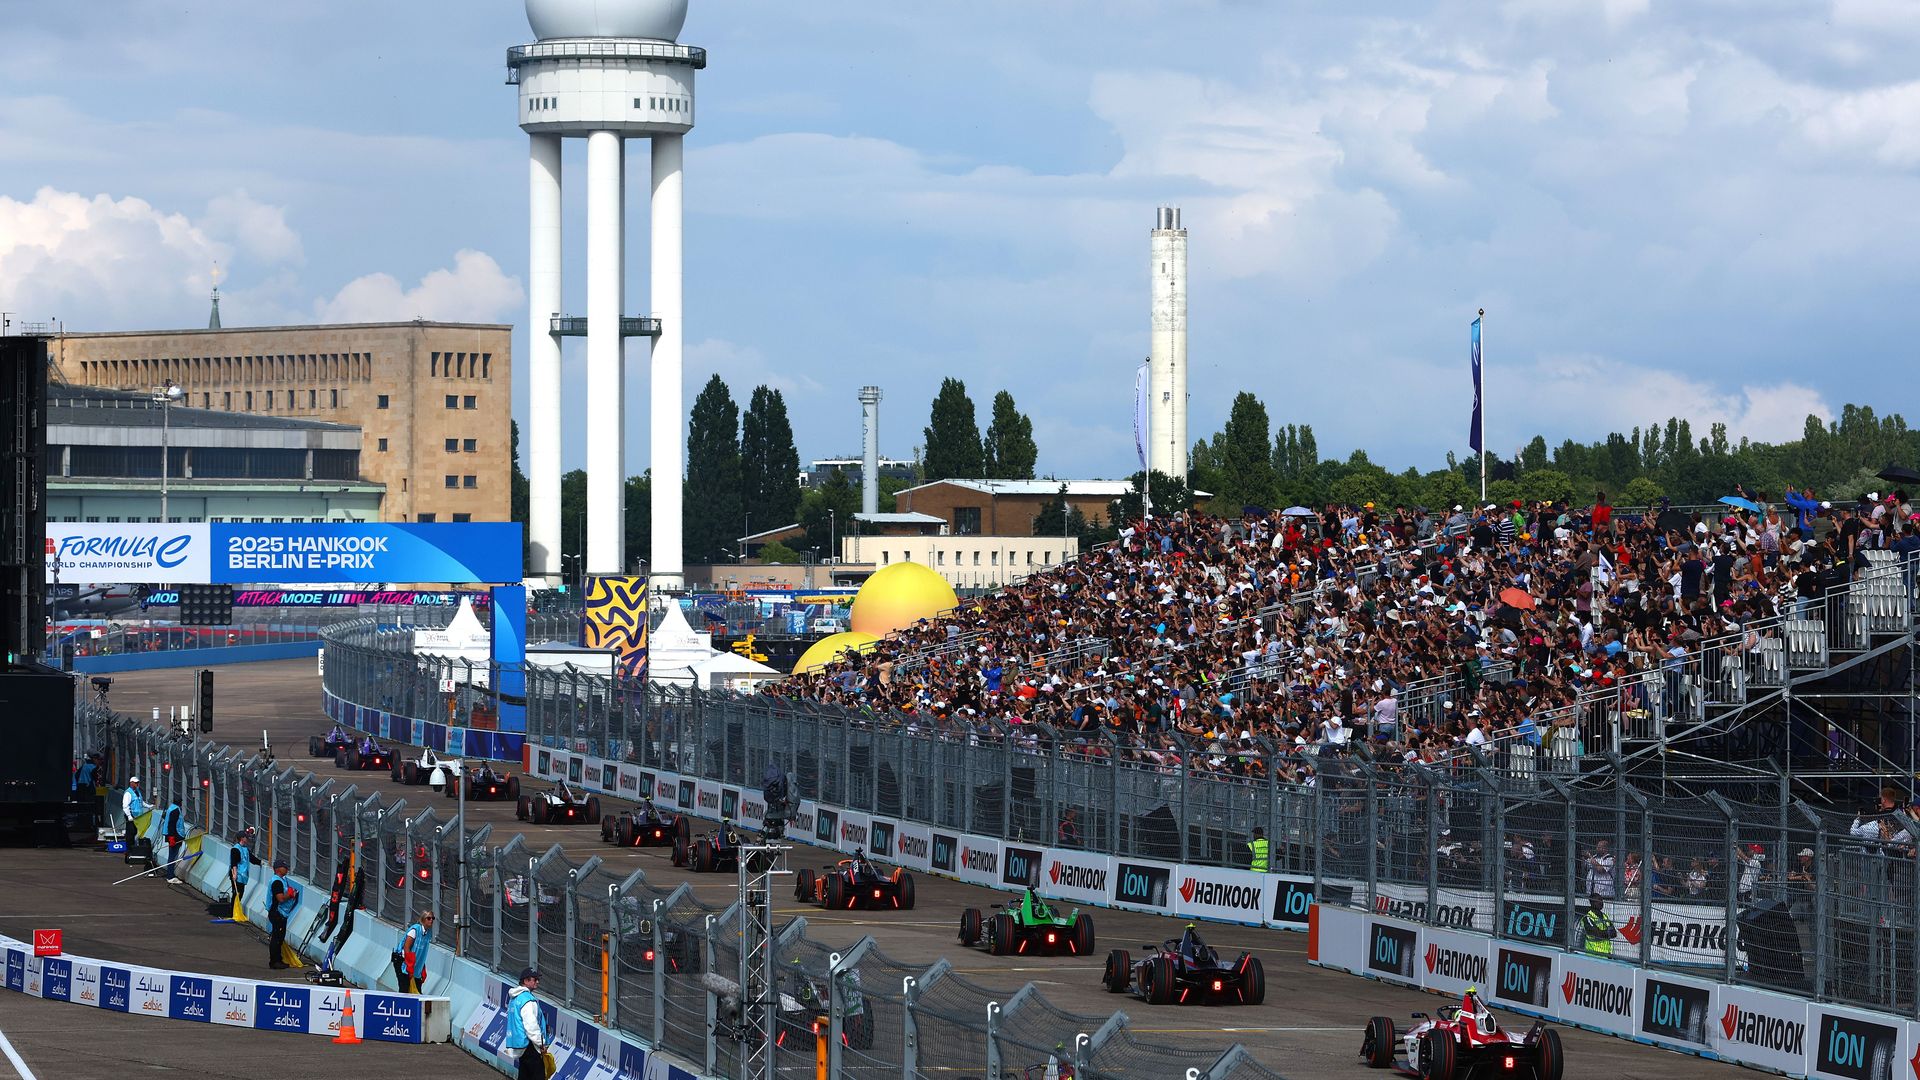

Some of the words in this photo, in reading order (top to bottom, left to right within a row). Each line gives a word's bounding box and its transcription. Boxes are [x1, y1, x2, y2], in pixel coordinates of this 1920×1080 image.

[58, 536, 158, 557] FORMULA
[229, 537, 284, 551] 2025
[288, 537, 388, 551] HANKOOK
[229, 554, 303, 568] BERLIN
[308, 554, 374, 568] E-PRIX
[51, 981, 67, 996] sabic
[80, 986, 95, 1001] sabic
[109, 990, 124, 1007] sabic
[142, 996, 163, 1011] sabic
[183, 1001, 204, 1017] sabic
[225, 1006, 247, 1022] sabic
[273, 1011, 300, 1028] sabic
[382, 1021, 410, 1038] sabic
